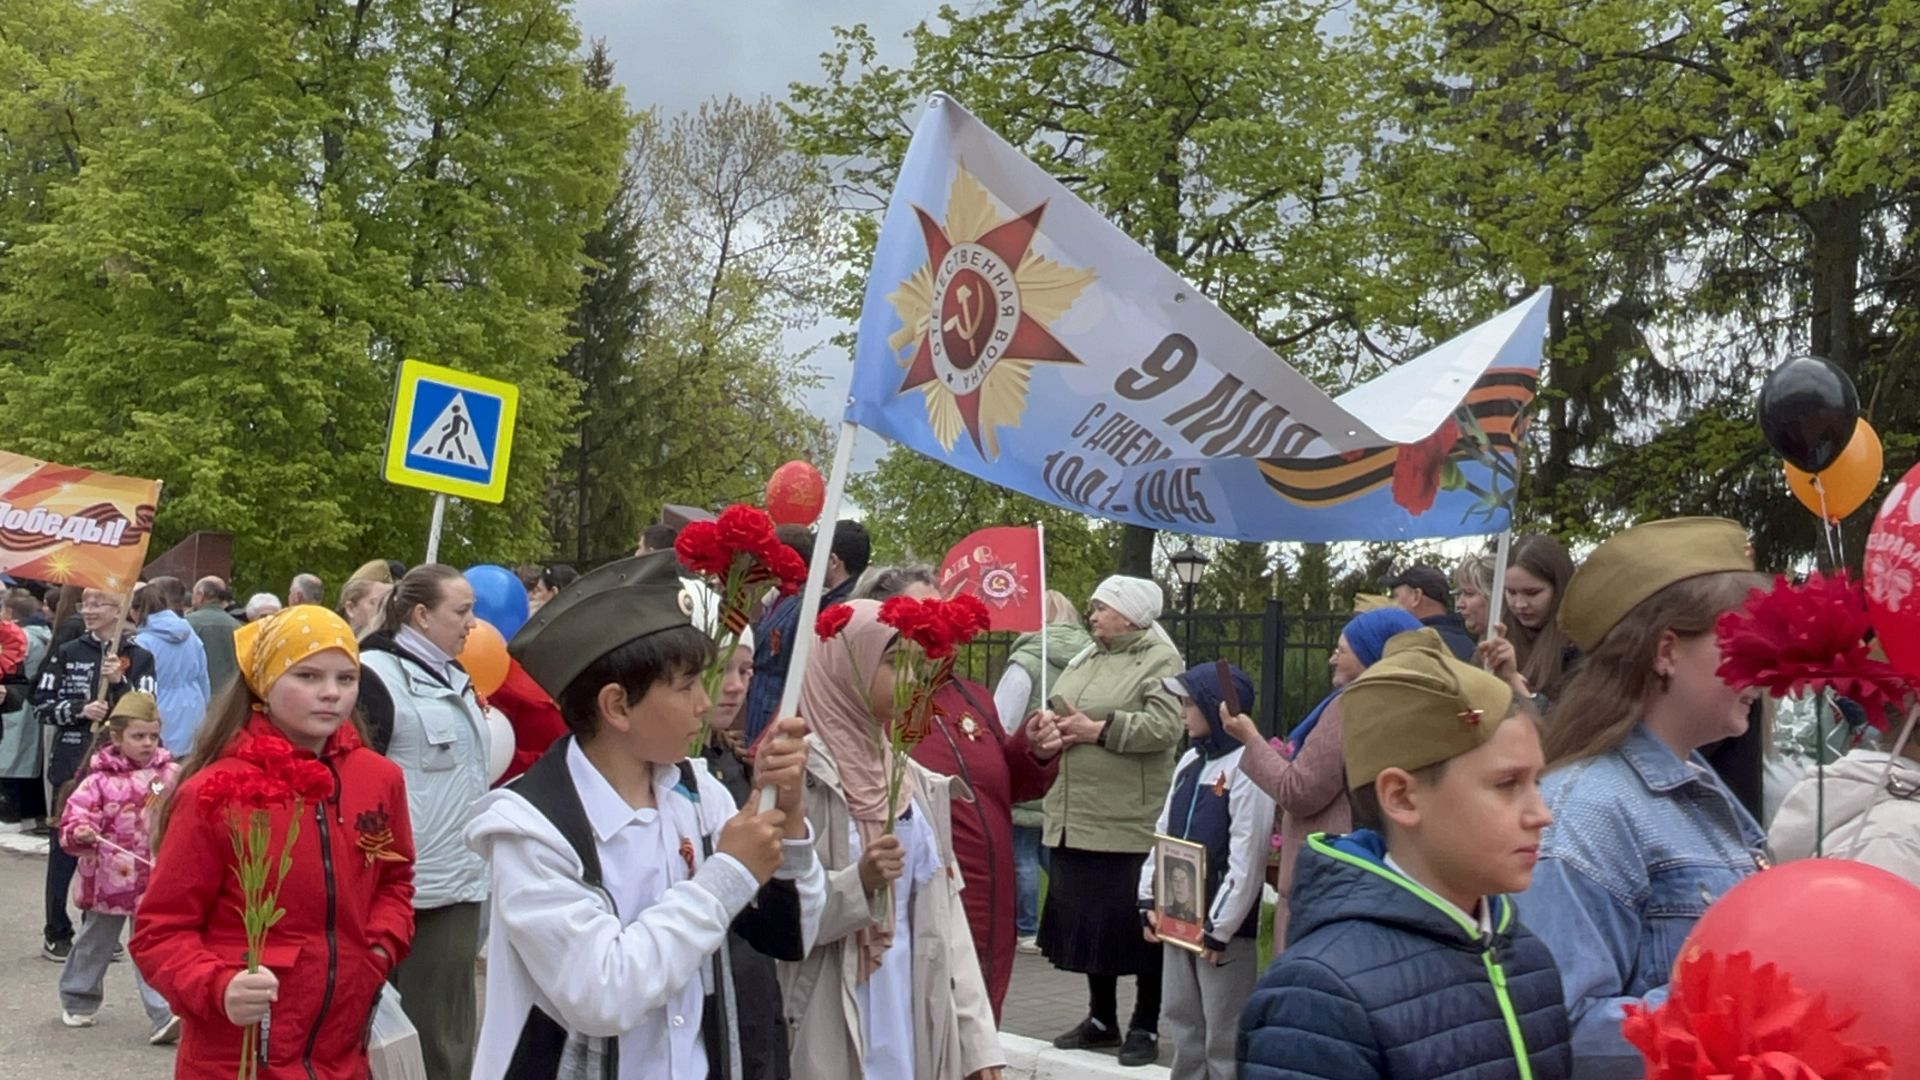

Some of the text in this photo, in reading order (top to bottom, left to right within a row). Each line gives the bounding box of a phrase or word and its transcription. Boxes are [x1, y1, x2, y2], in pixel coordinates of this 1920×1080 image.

[1070, 402, 1108, 438] С
[1114, 333, 1323, 459] 9 МАЯ
